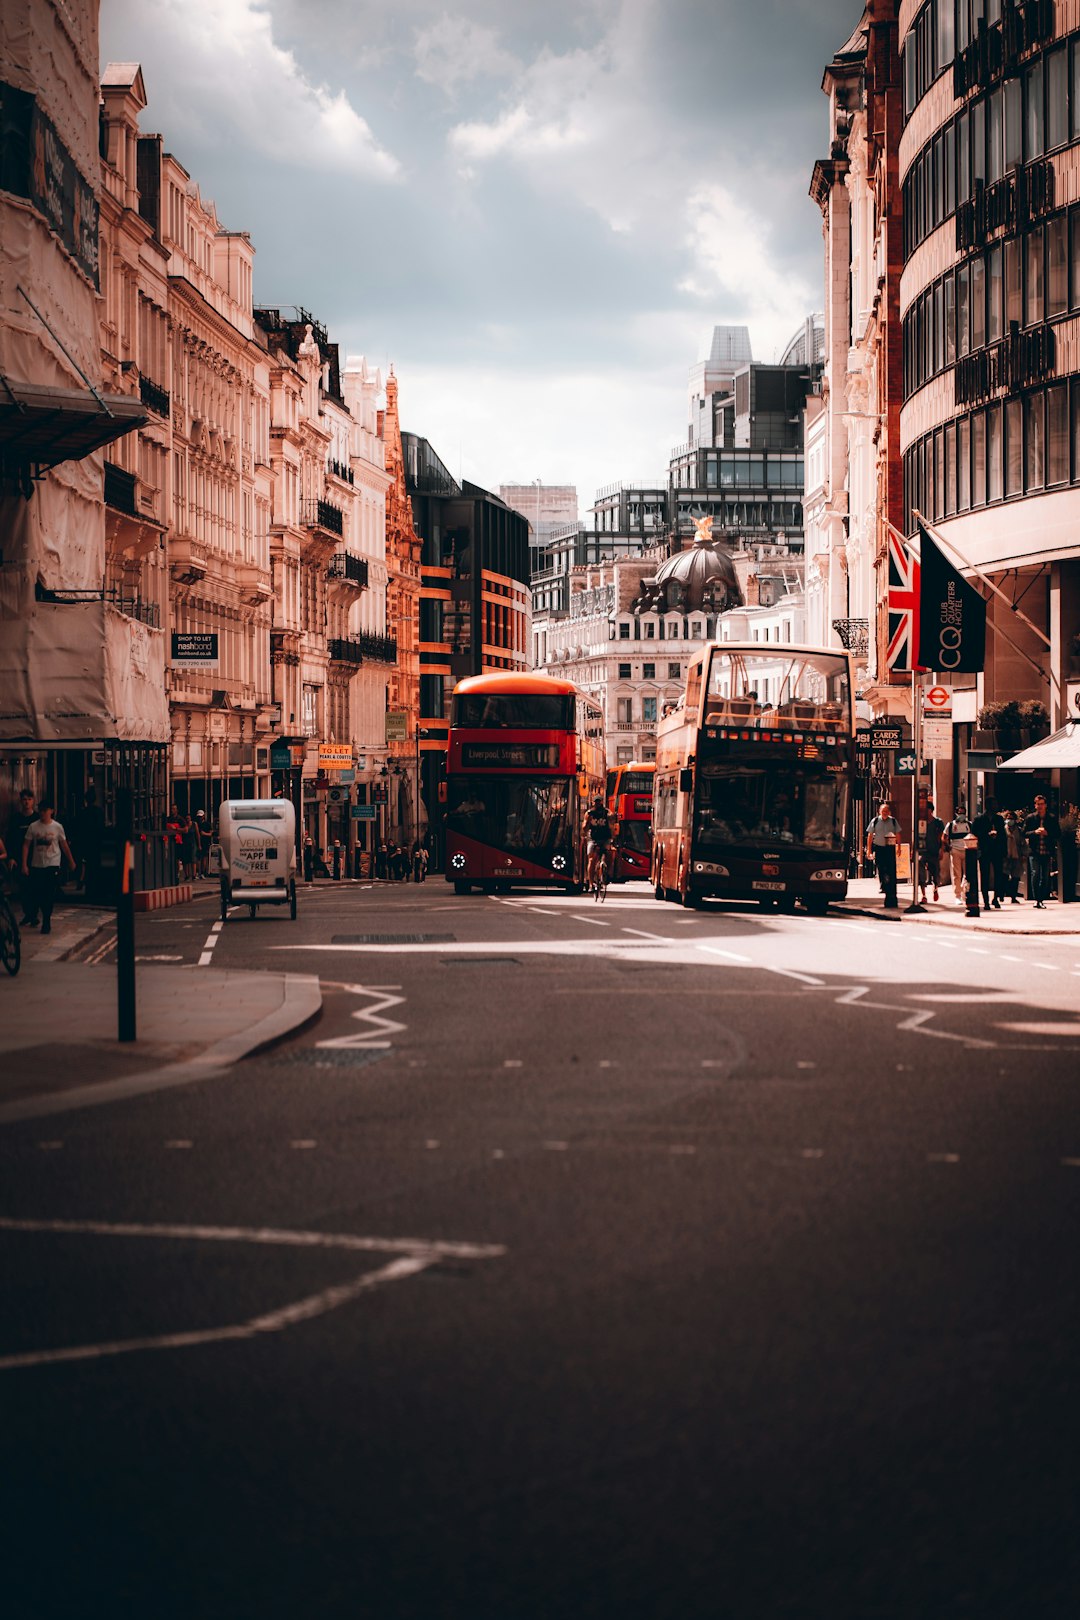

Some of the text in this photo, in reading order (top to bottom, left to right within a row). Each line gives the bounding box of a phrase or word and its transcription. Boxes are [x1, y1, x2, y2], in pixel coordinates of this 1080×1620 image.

[947, 580, 956, 624] QUARTERS
[940, 601, 949, 624] CLUB
[955, 598, 963, 625] HOTEL
[177, 642, 213, 651] nashbond
[938, 626, 963, 669] CQ
[873, 732, 899, 740] CARDS
[871, 739, 900, 747] GALORE
[468, 749, 501, 761] Liverpool
[502, 749, 524, 760] Street
[246, 852, 264, 861] APP
[250, 863, 268, 871] FREE
